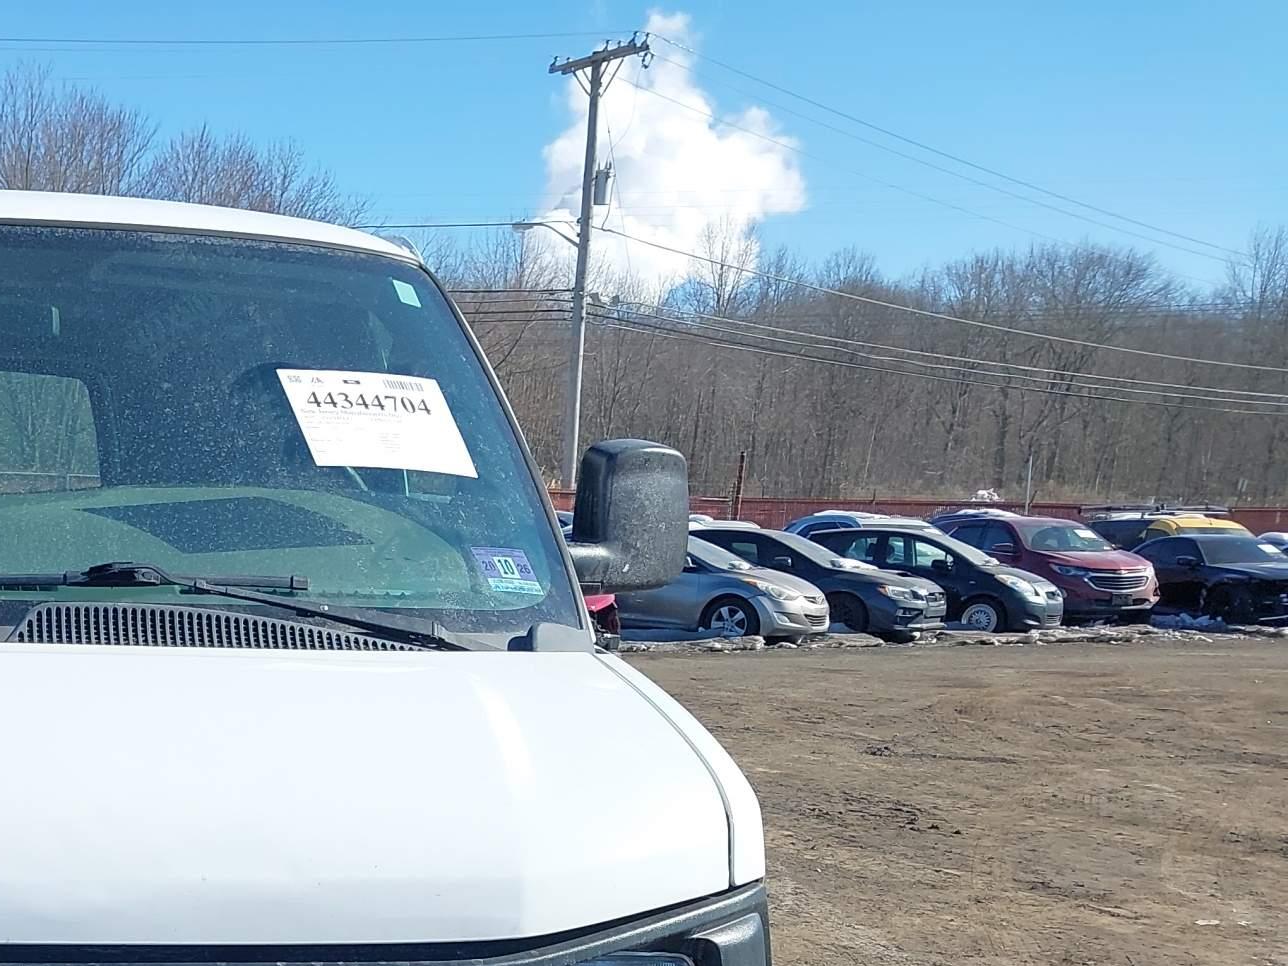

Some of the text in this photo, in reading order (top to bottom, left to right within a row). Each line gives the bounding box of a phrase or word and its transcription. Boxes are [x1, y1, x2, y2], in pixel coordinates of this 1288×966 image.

[307, 391, 432, 416] 44344704
[497, 558, 515, 575] 10
[516, 563, 532, 575] 26
